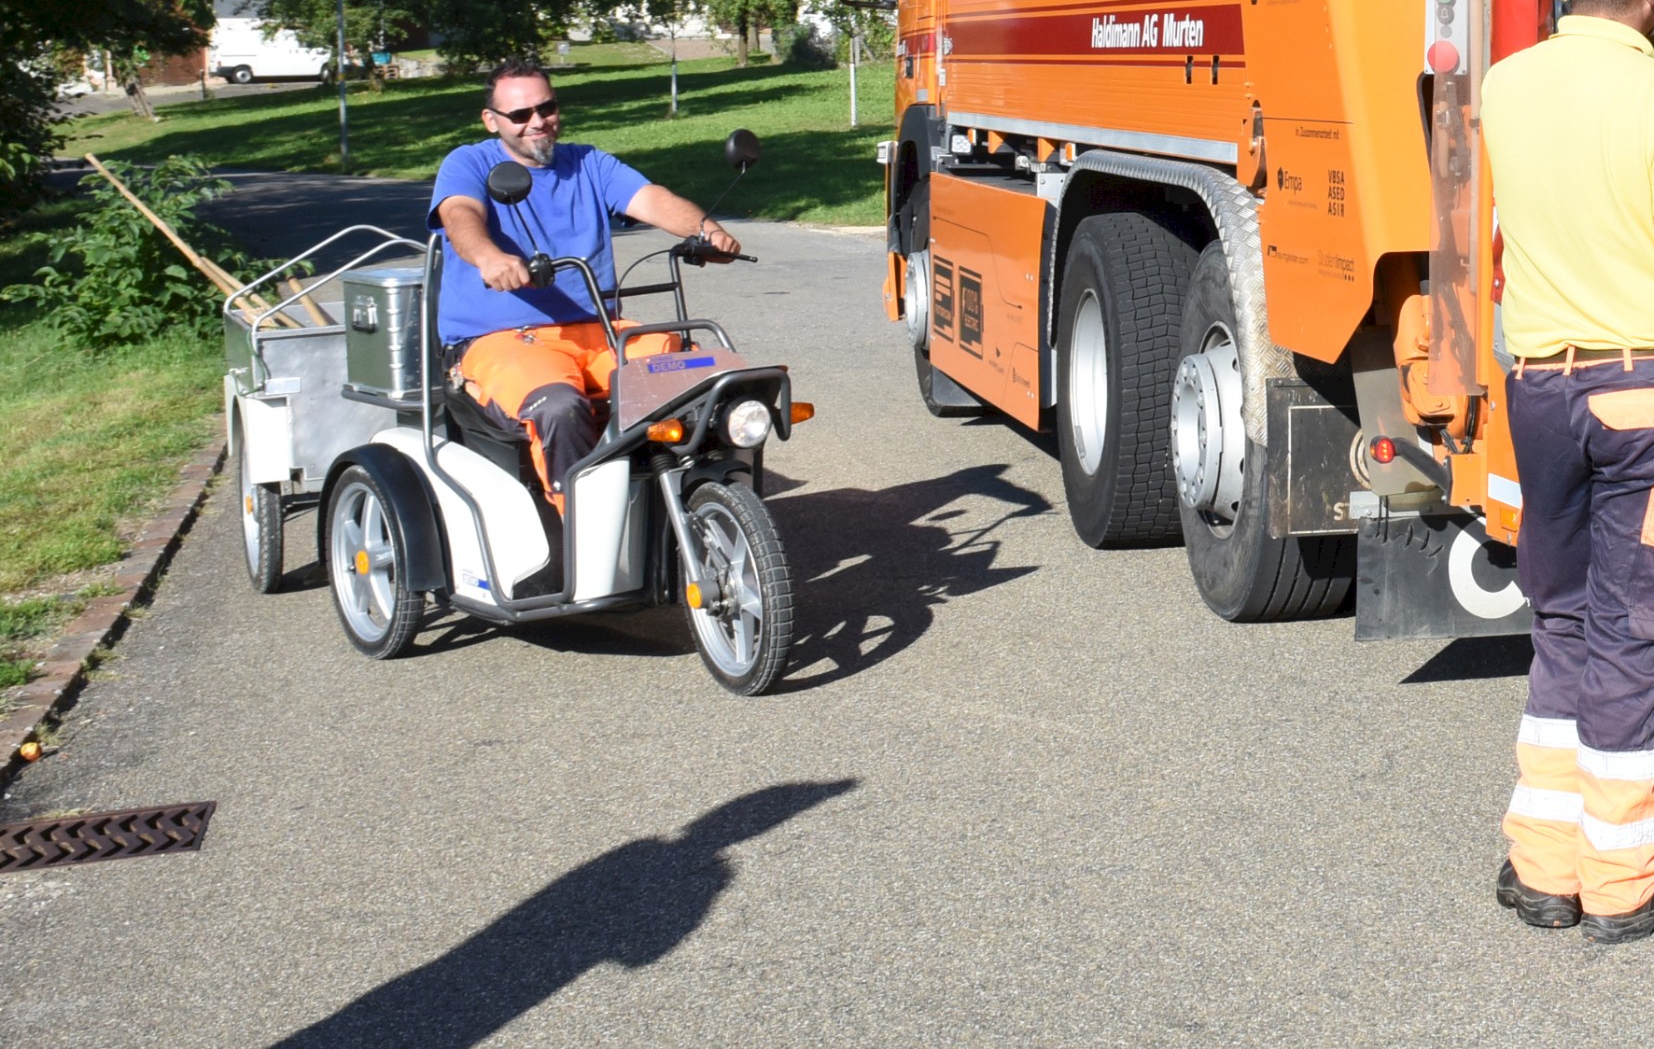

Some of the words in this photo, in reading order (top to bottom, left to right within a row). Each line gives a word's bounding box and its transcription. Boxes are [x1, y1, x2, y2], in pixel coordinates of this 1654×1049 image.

[1091, 13, 1141, 48] Haldimann
[1142, 13, 1158, 48] AG
[1162, 12, 1204, 48] Murten
[1284, 170, 1302, 195] Empa
[1328, 169, 1345, 185] VBSA
[1328, 186, 1345, 201] ASED
[1328, 203, 1345, 217] ASIR
[653, 361, 686, 373] DEMO
